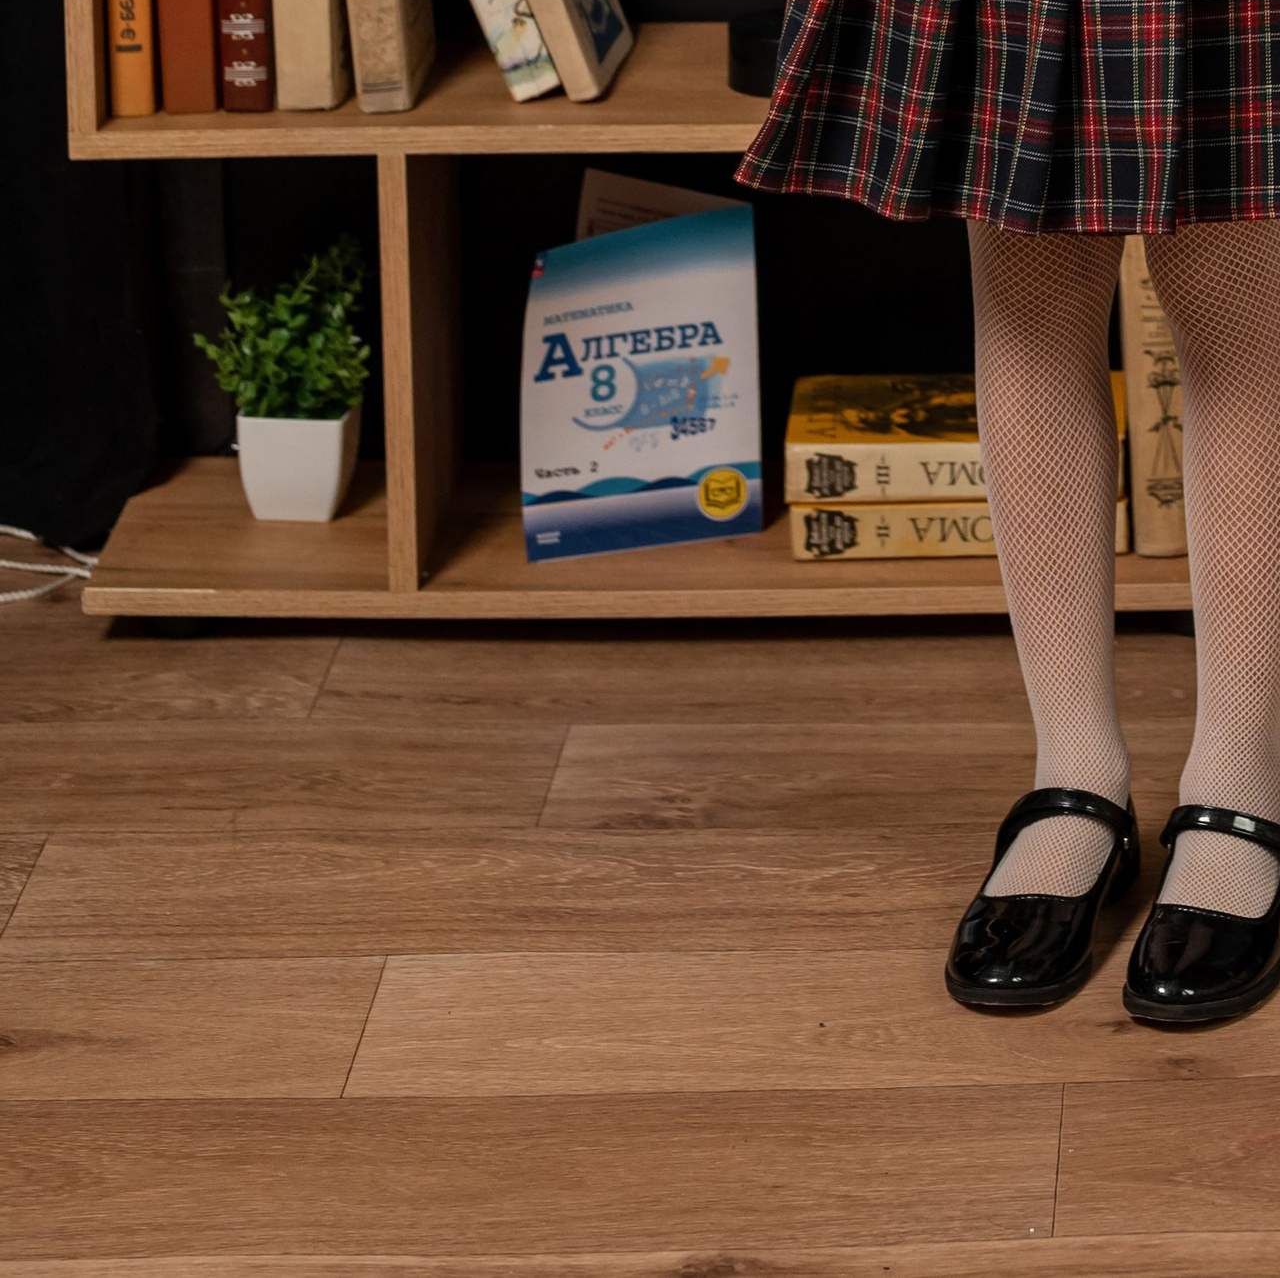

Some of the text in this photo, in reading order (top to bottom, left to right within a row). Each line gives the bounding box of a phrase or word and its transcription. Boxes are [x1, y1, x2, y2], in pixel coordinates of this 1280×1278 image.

[543, 301, 634, 327] МАТЕМАТИКА
[533, 321, 724, 383] АЛГЕБРА
[590, 364, 616, 402] 8
[534, 461, 600, 480] Часть 2
